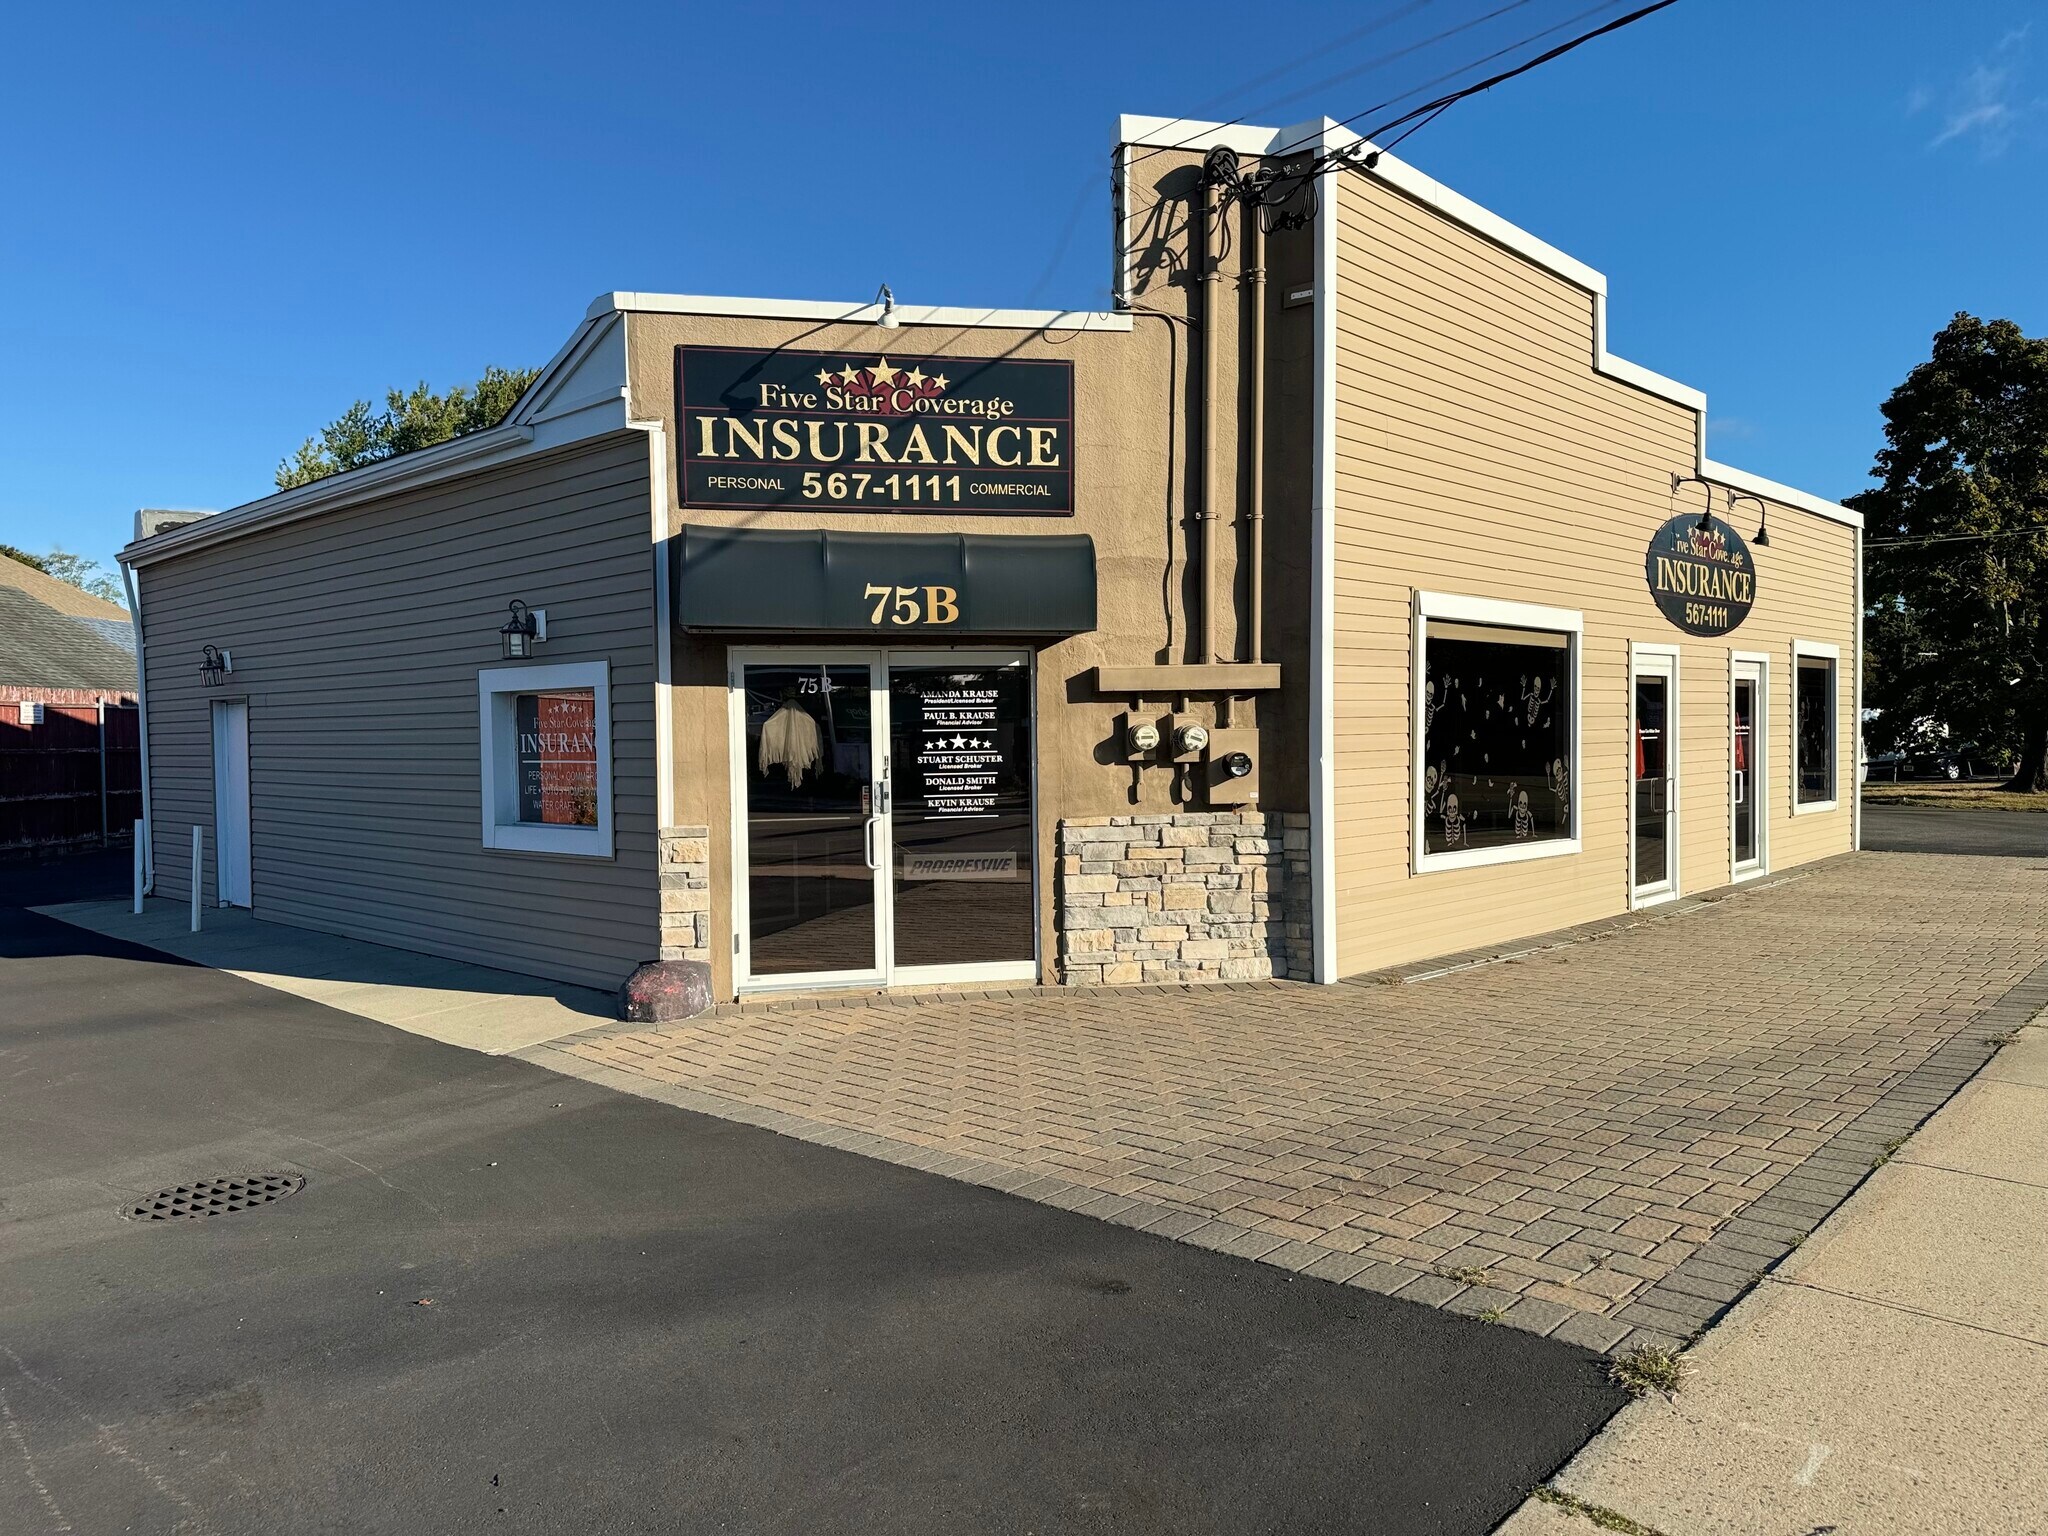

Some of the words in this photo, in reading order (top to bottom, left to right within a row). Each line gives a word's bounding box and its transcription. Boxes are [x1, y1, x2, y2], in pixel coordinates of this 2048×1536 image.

[760, 383, 817, 409] Five
[826, 386, 884, 412] Star
[891, 389, 1014, 419] Coverage
[696, 416, 1059, 466] INSURANCE
[708, 476, 785, 490] PERSONAL
[802, 472, 960, 501] 567-1111
[970, 483, 1051, 496] COMMERCIAL
[1691, 538, 1707, 557] Star
[1657, 556, 1751, 603] INSURANCE
[864, 583, 959, 625] 75B
[1686, 602, 1727, 628] 567-1111
[798, 677, 832, 693] 75B
[534, 718, 548, 728] Five
[550, 717, 564, 728] Star
[918, 756, 953, 764] STUART
[529, 771, 560, 780] PERSONAL
[525, 786, 537, 794] LIFE
[911, 858, 1012, 874] PROGRESSIVE
